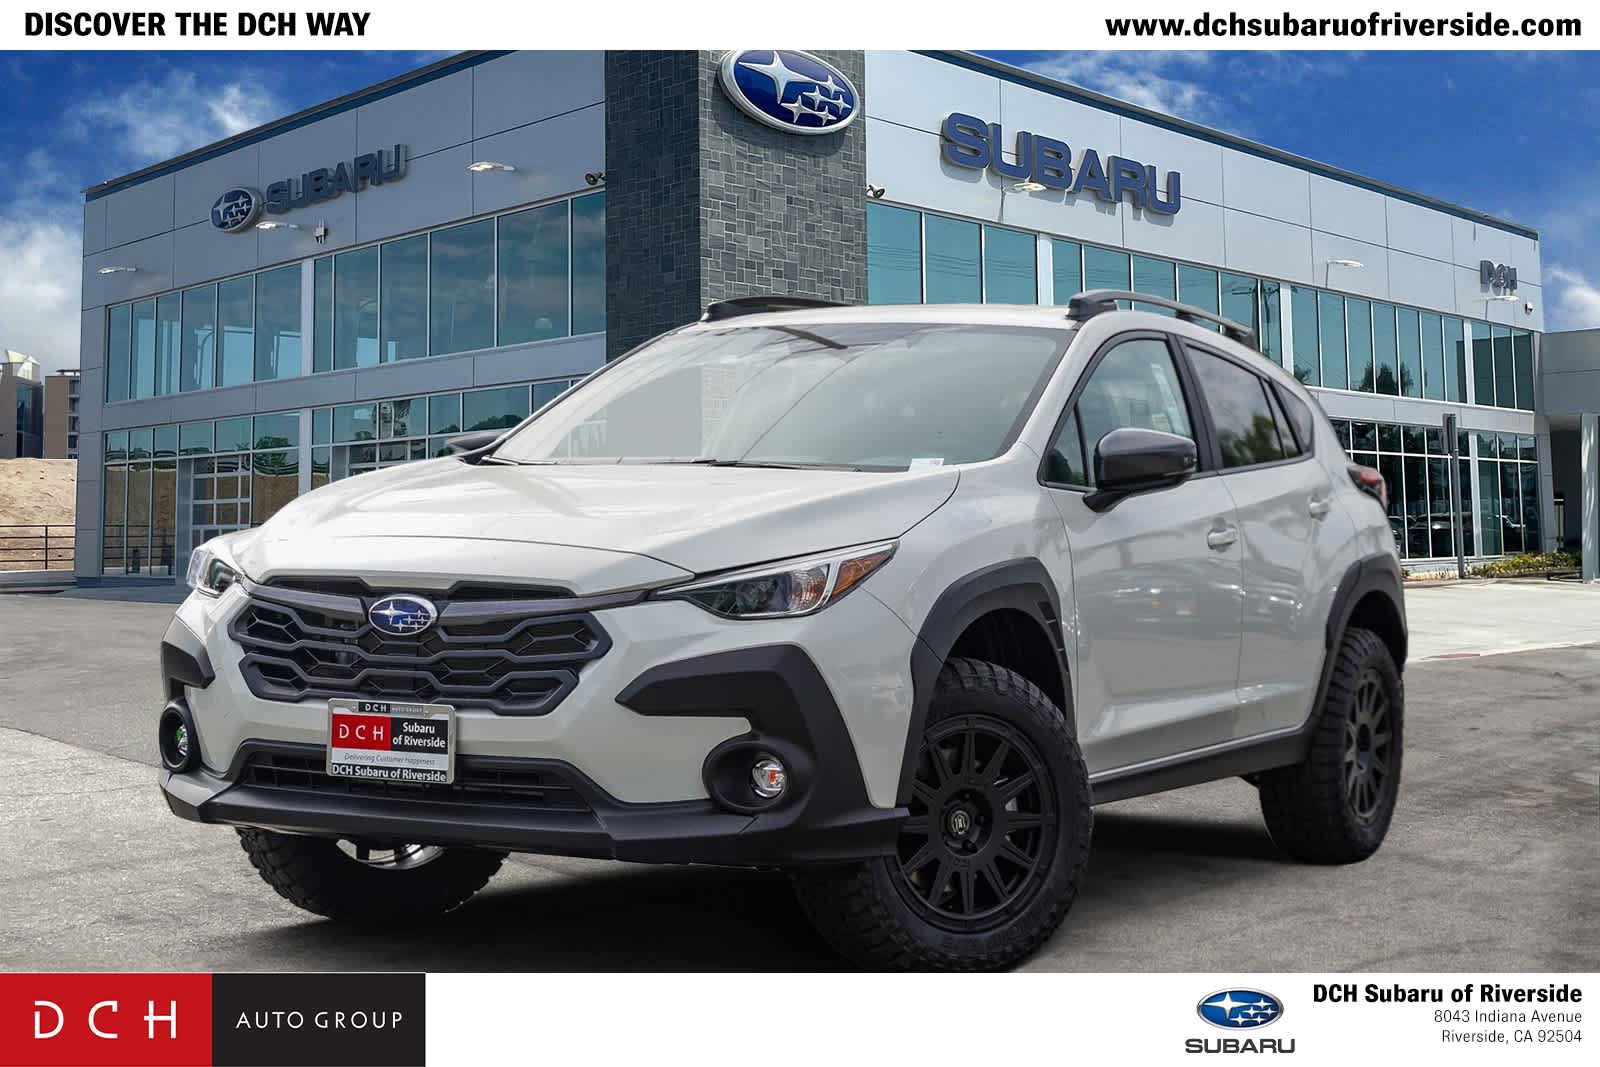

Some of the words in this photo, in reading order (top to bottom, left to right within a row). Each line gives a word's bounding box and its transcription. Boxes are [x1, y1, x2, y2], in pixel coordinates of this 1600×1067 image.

[940, 112, 1181, 215] SUBARU
[266, 144, 408, 215] SUBARU
[364, 703, 387, 713] DCH
[339, 724, 385, 741] DCH
[402, 721, 435, 734] Subaru
[392, 734, 402, 745] of
[404, 735, 446, 749] Riverside
[332, 764, 354, 775] DCH
[355, 766, 389, 778] Subaru
[390, 768, 401, 778] of
[402, 770, 446, 783] Riverside
